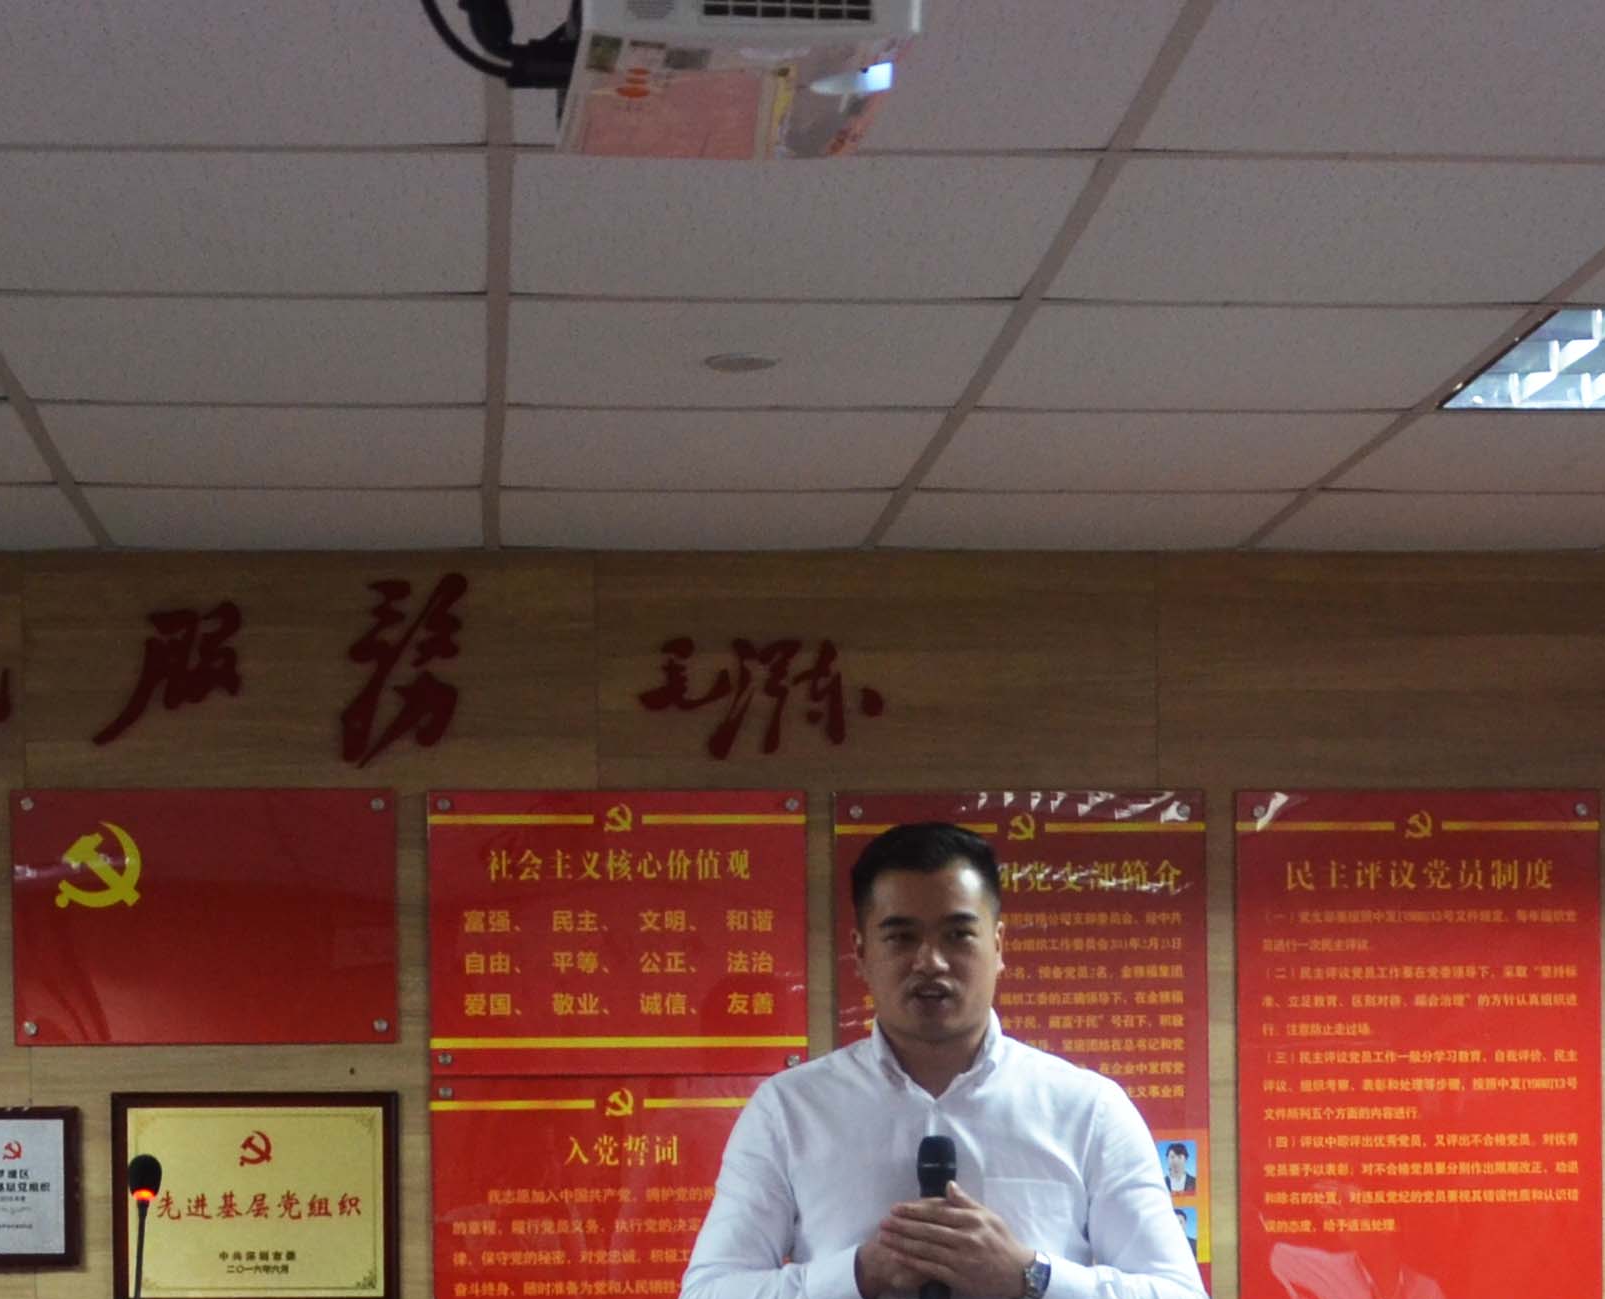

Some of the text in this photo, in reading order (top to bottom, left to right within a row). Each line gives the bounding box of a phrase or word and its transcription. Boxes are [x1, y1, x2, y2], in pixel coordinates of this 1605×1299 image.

[489, 849, 751, 881] 社会主义核心价值观
[1286, 860, 1553, 890] 民主评议党员制度
[564, 1135, 679, 1167] 入党誓词
[157, 1190, 362, 1220] 先进基层党组织
